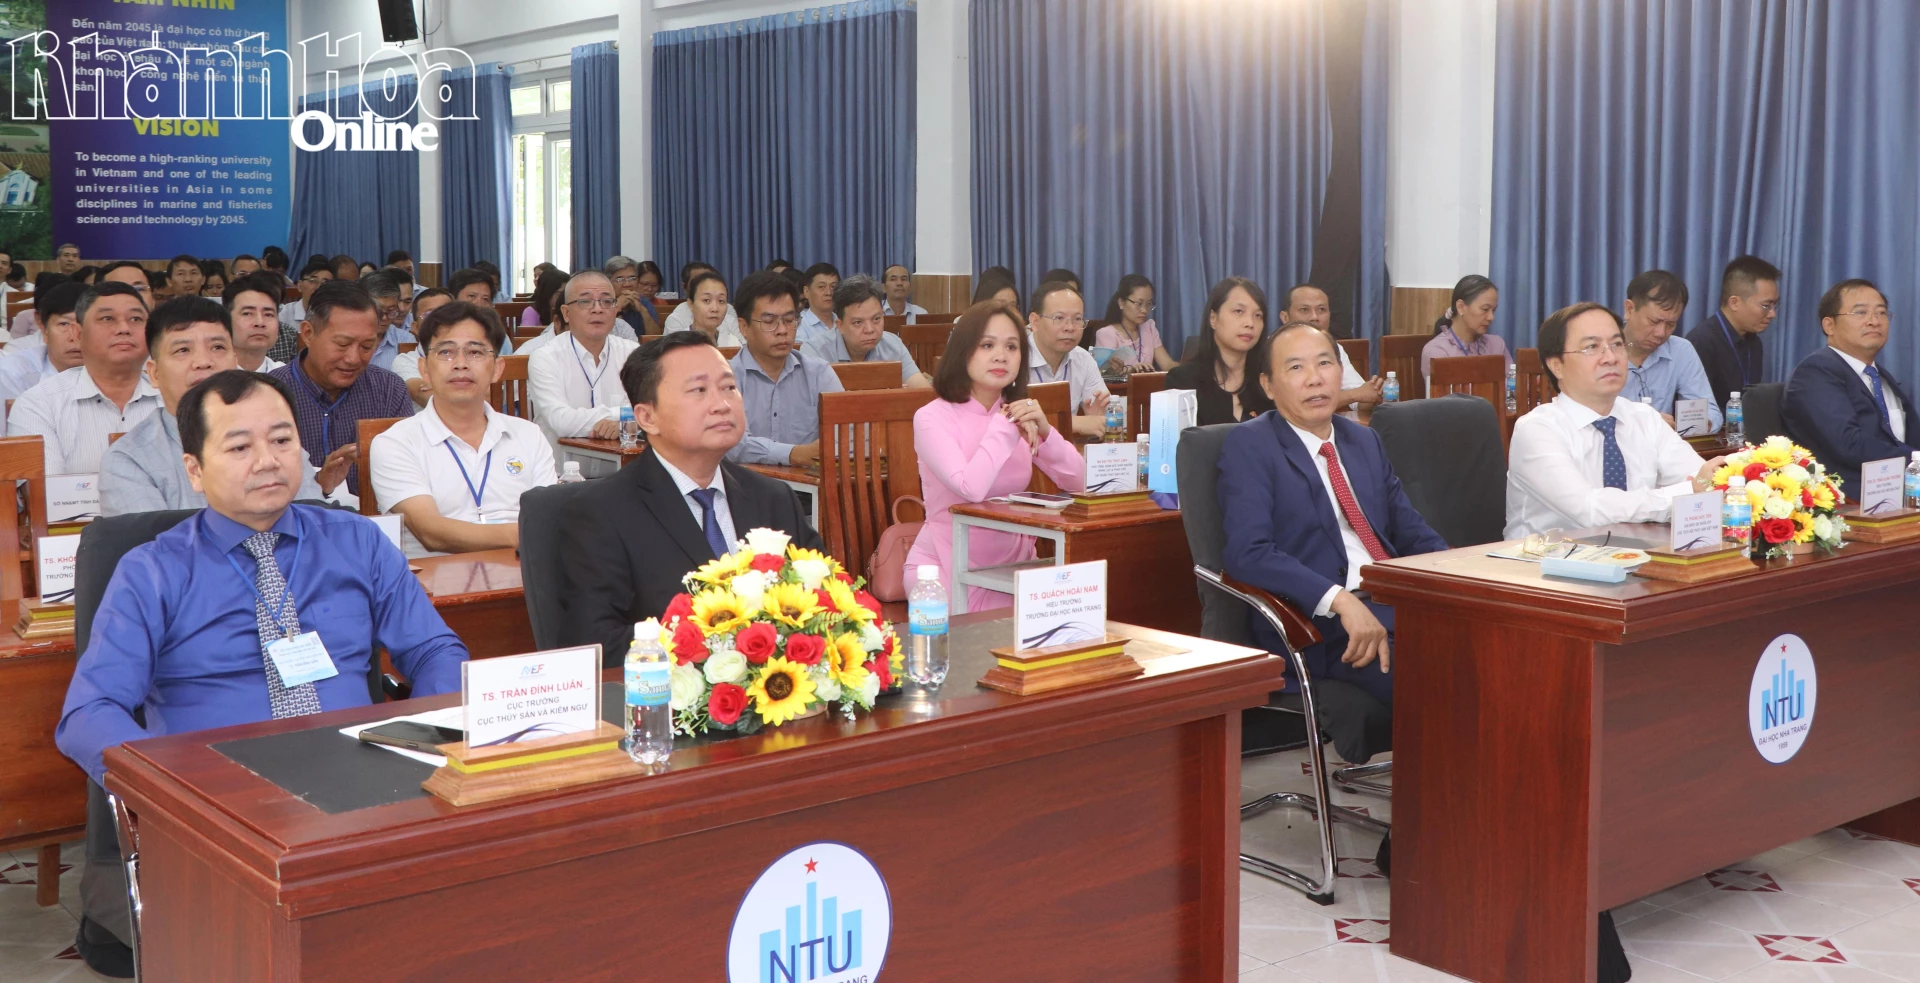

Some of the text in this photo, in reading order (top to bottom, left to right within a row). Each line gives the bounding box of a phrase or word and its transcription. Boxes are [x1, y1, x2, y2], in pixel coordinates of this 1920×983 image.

[72, 18, 94, 28] Đến
[98, 21, 122, 30] năm
[126, 22, 151, 32] 2045
[154, 24, 164, 32] là
[167, 25, 183, 36] đại
[186, 26, 206, 36] học
[209, 27, 222, 36] có
[224, 28, 242, 37] thứ
[116, 37, 137, 48] Việt
[220, 56, 233, 66] số
[133, 117, 219, 137] VISION
[75, 152, 90, 161] To
[92, 152, 136, 162] become
[150, 154, 218, 166] high-ranking
[222, 156, 272, 167] university
[76, 168, 86, 176] in
[92, 168, 137, 178] Vietnam
[144, 170, 164, 178] and
[196, 170, 206, 178] of
[212, 170, 228, 179] the
[235, 170, 272, 182] leading
[76, 184, 159, 193] universities
[167, 184, 178, 193] in
[186, 184, 214, 194] Asia
[221, 185, 232, 194] in
[76, 199, 272, 210] disciplines in marine and fisheries
[76, 214, 248, 226] science and technology by 2045.
[1041, 589, 1064, 599] QUÁCH
[1084, 584, 1098, 593] NAM
[482, 692, 497, 702] TS.
[507, 702, 524, 710] CỤC
[1766, 692, 1800, 730] NTU
[478, 716, 494, 726] CỤC
[1768, 732, 1778, 742] HỌC
[1780, 729, 1790, 738] NHA
[1790, 724, 1808, 734] TRANG
[770, 930, 852, 983] NTU
